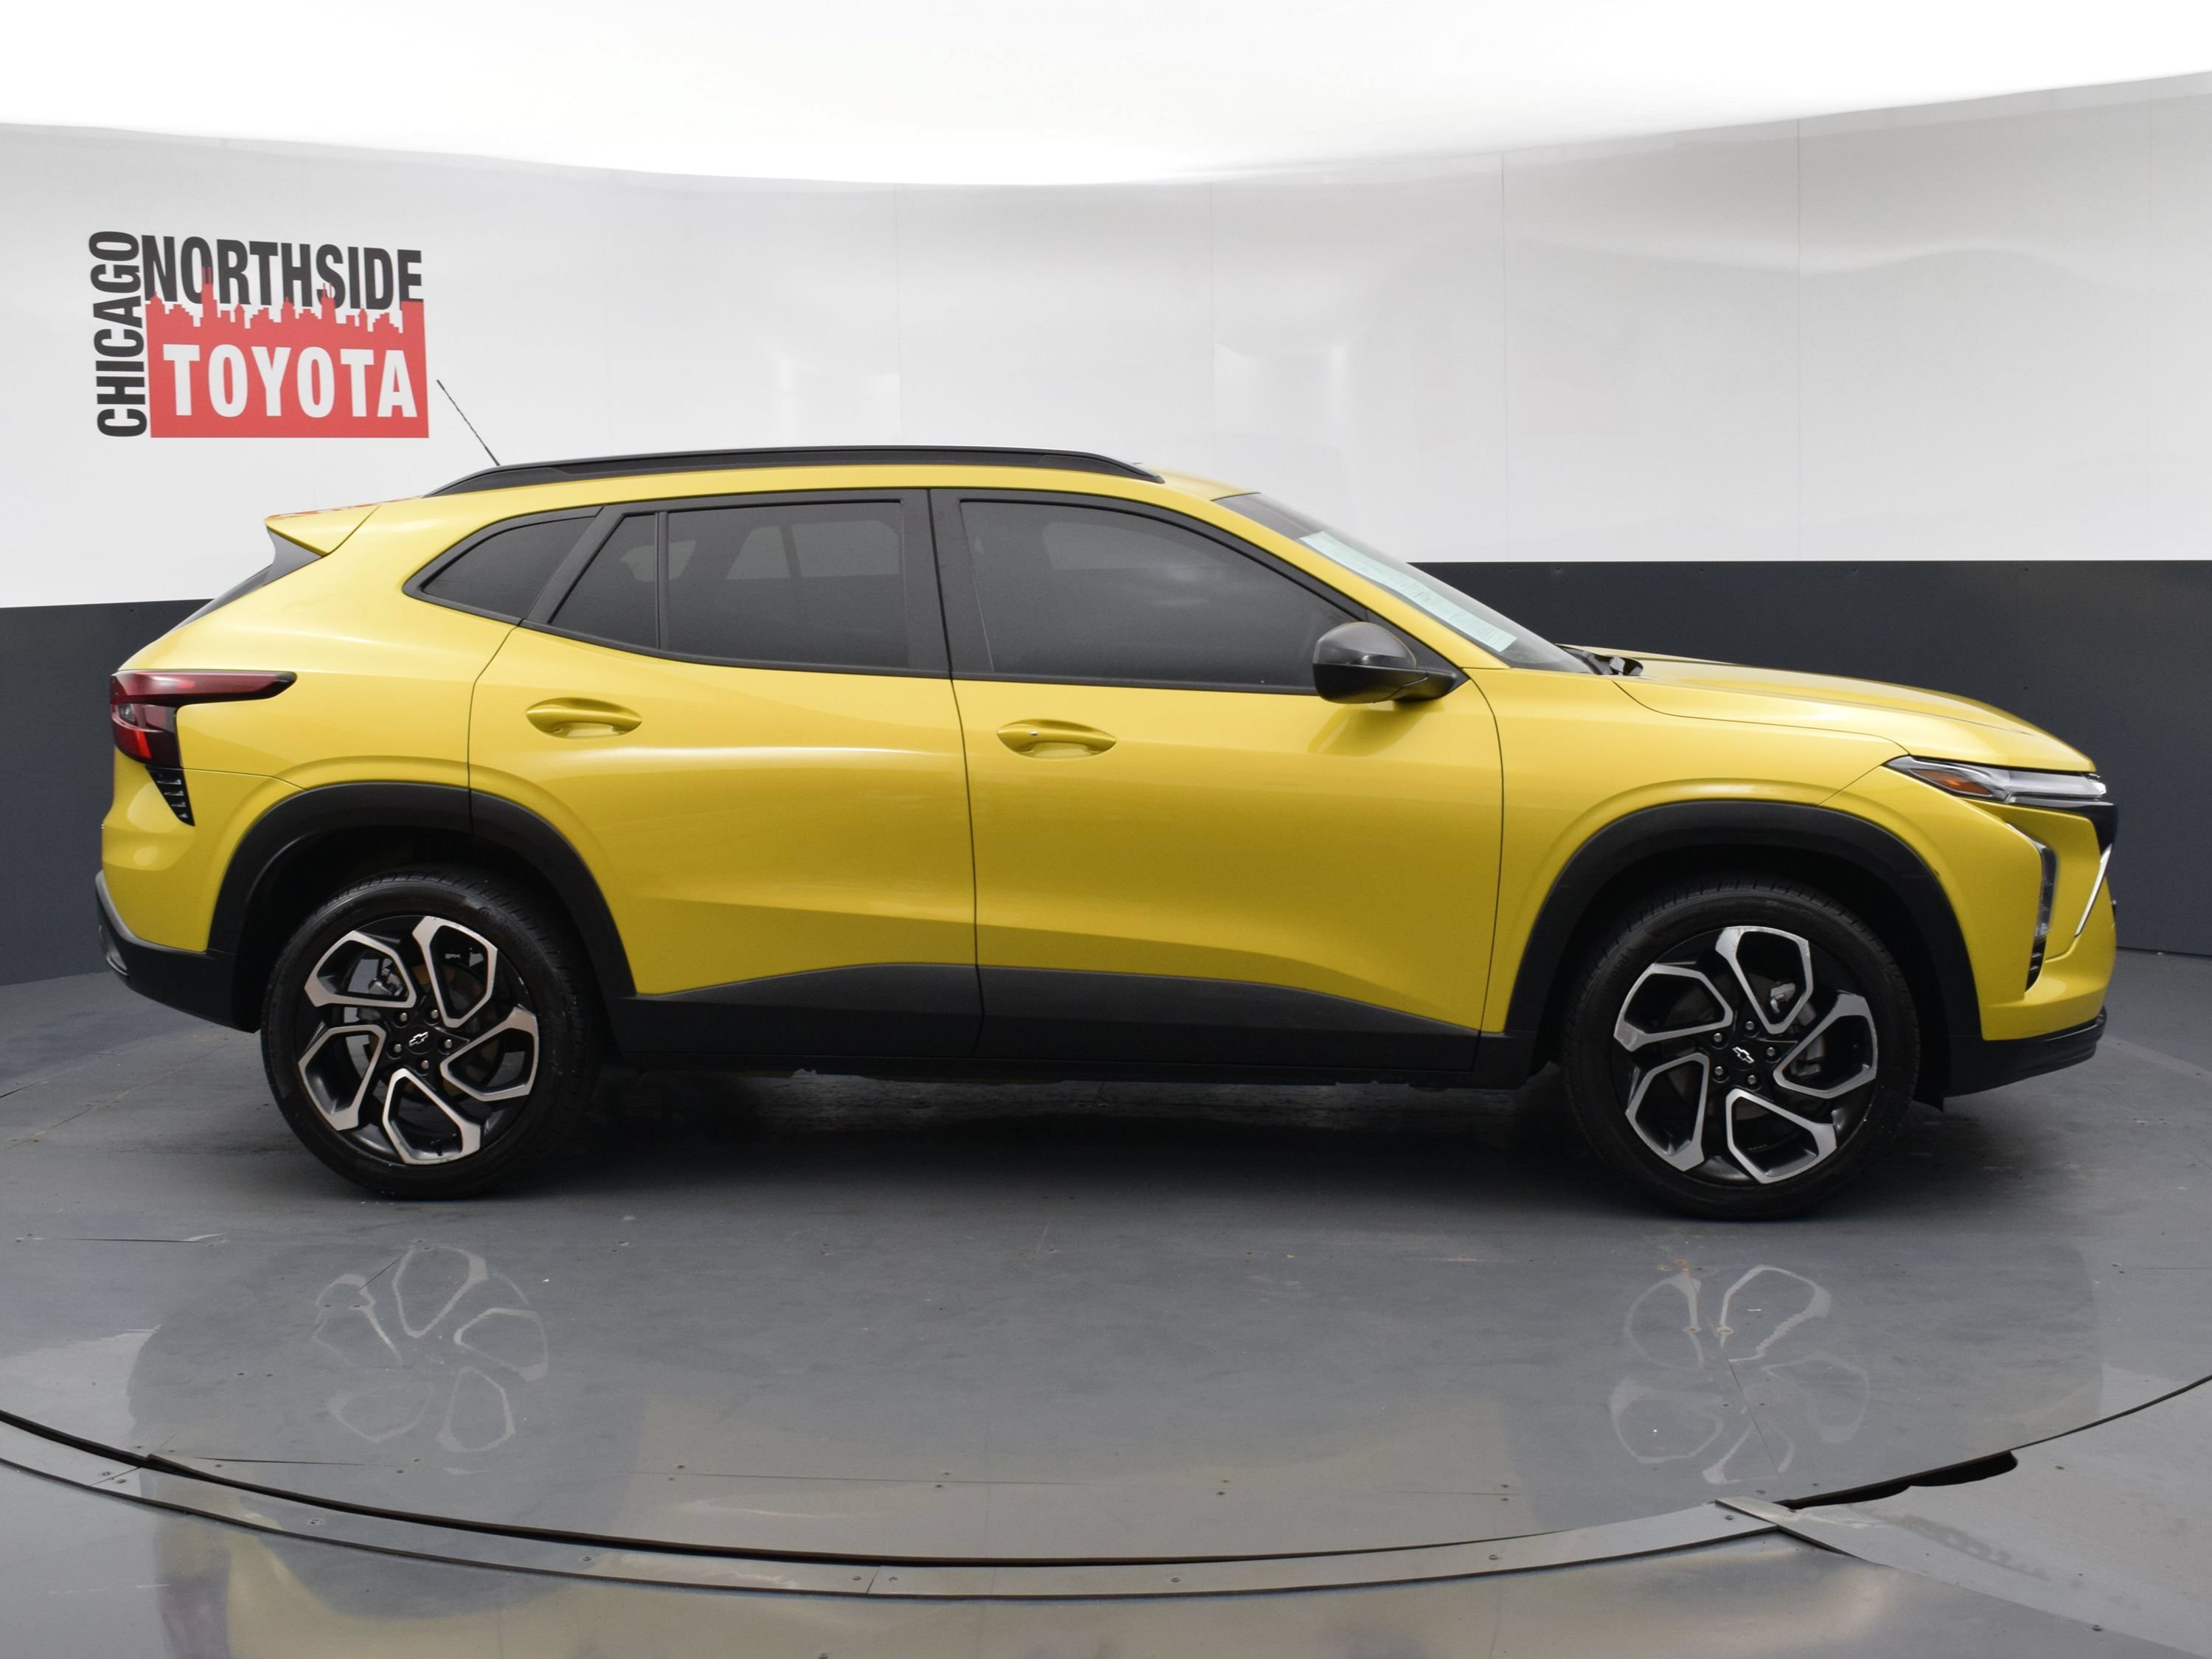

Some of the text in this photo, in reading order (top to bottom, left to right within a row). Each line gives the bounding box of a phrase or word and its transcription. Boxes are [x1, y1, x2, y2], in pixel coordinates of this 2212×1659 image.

[142, 234, 424, 310] NORTHSIDE
[88, 231, 147, 437] CHICAGO
[163, 344, 417, 418] TOYOTA
